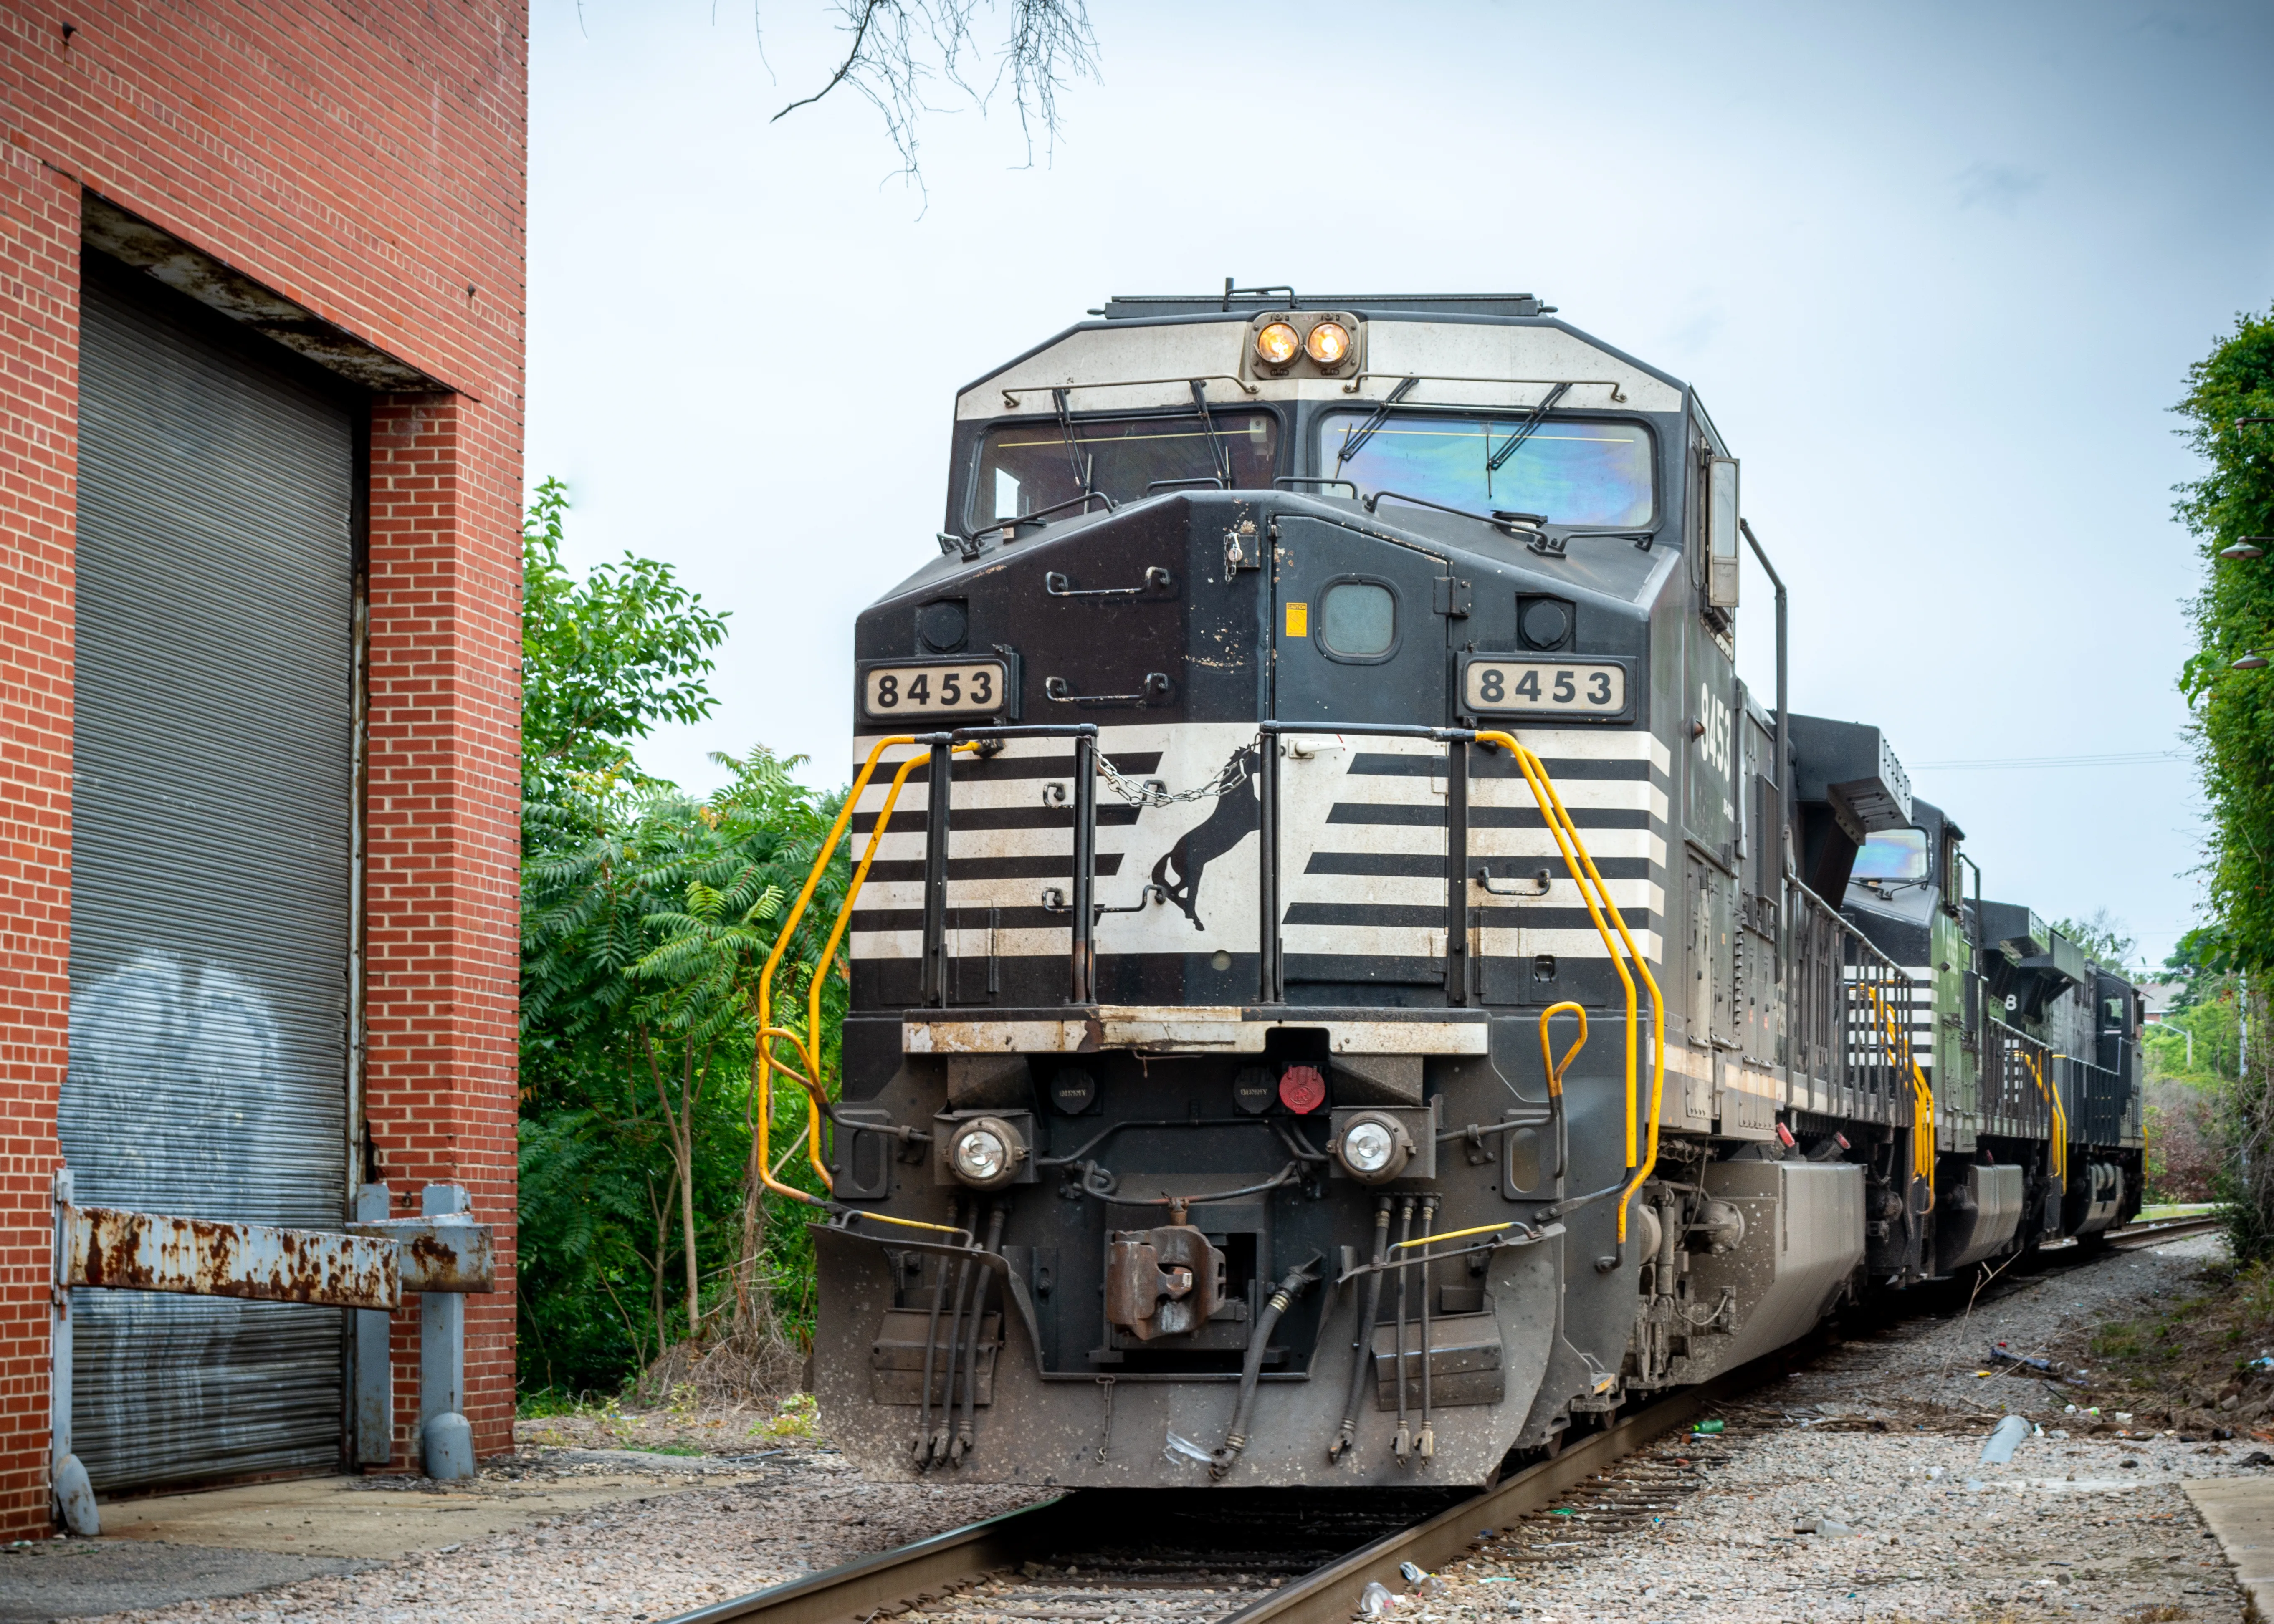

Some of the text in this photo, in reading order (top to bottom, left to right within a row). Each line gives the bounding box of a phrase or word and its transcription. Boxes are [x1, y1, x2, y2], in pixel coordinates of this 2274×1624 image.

[878, 671, 992, 708] 8453
[1480, 669, 1611, 705] 8453
[1701, 682, 1730, 783] 8453
[2005, 994, 2017, 1010] 8
